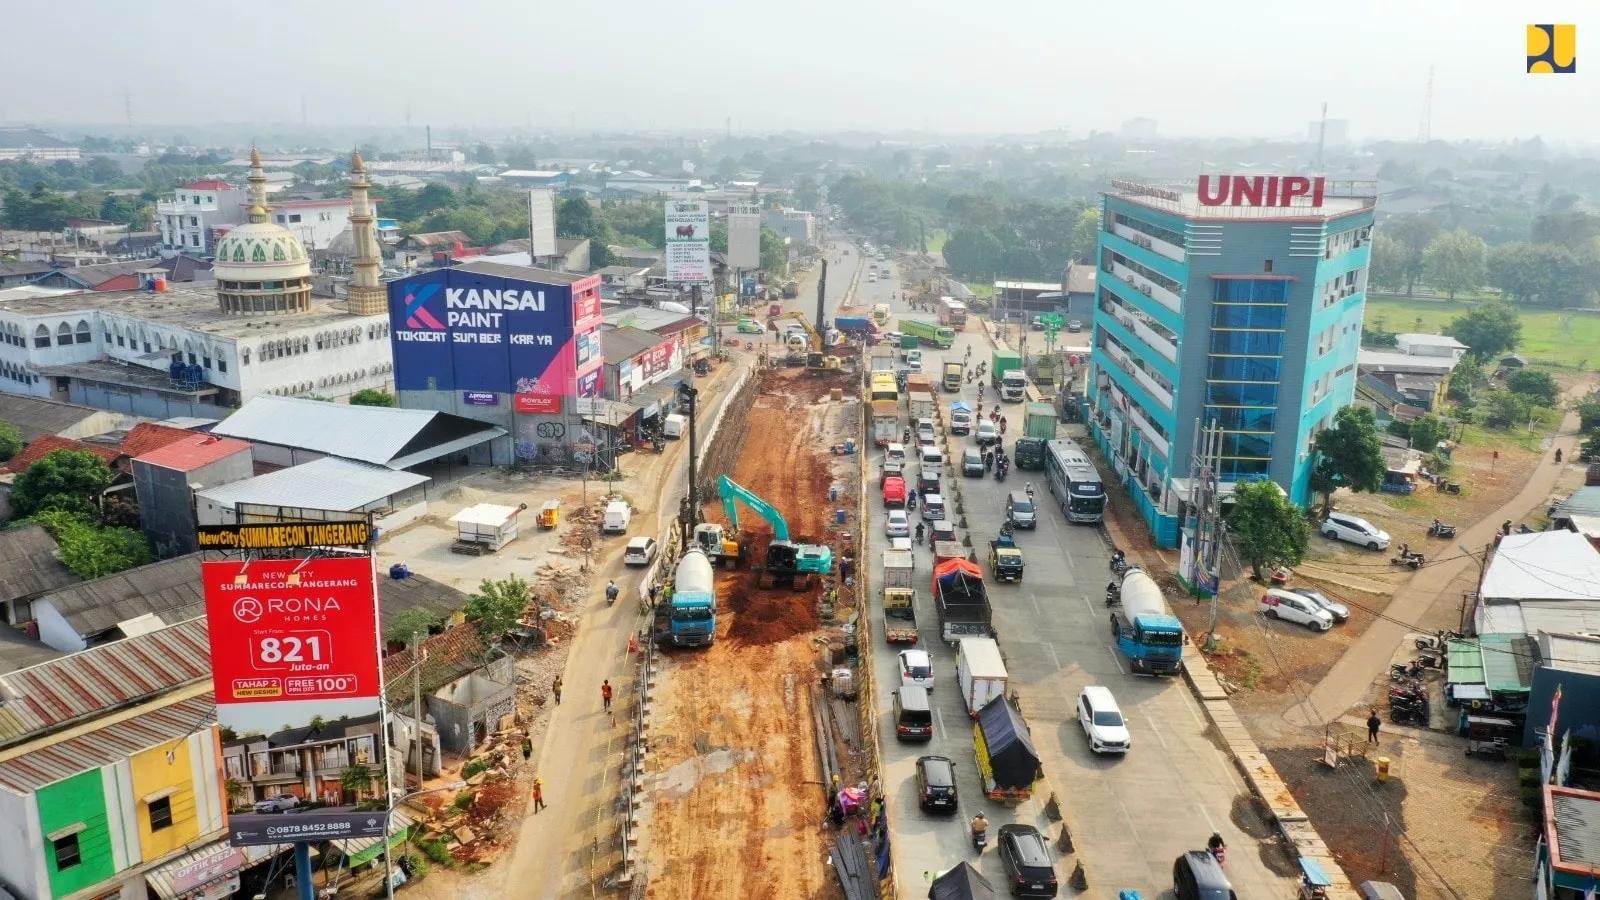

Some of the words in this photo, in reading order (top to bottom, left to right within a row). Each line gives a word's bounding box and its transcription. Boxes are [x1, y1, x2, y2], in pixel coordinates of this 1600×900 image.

[1198, 175, 1326, 207] UNIPI
[446, 288, 545, 311] KANSAI
[448, 312, 502, 328] PAINT
[240, 526, 306, 547] SUMMARECON
[307, 524, 366, 545] TANGERANG
[269, 597, 340, 613] RONA
[260, 636, 320, 663] 821
[289, 663, 329, 672] Juta-an
[177, 859, 209, 878] OPTIK
